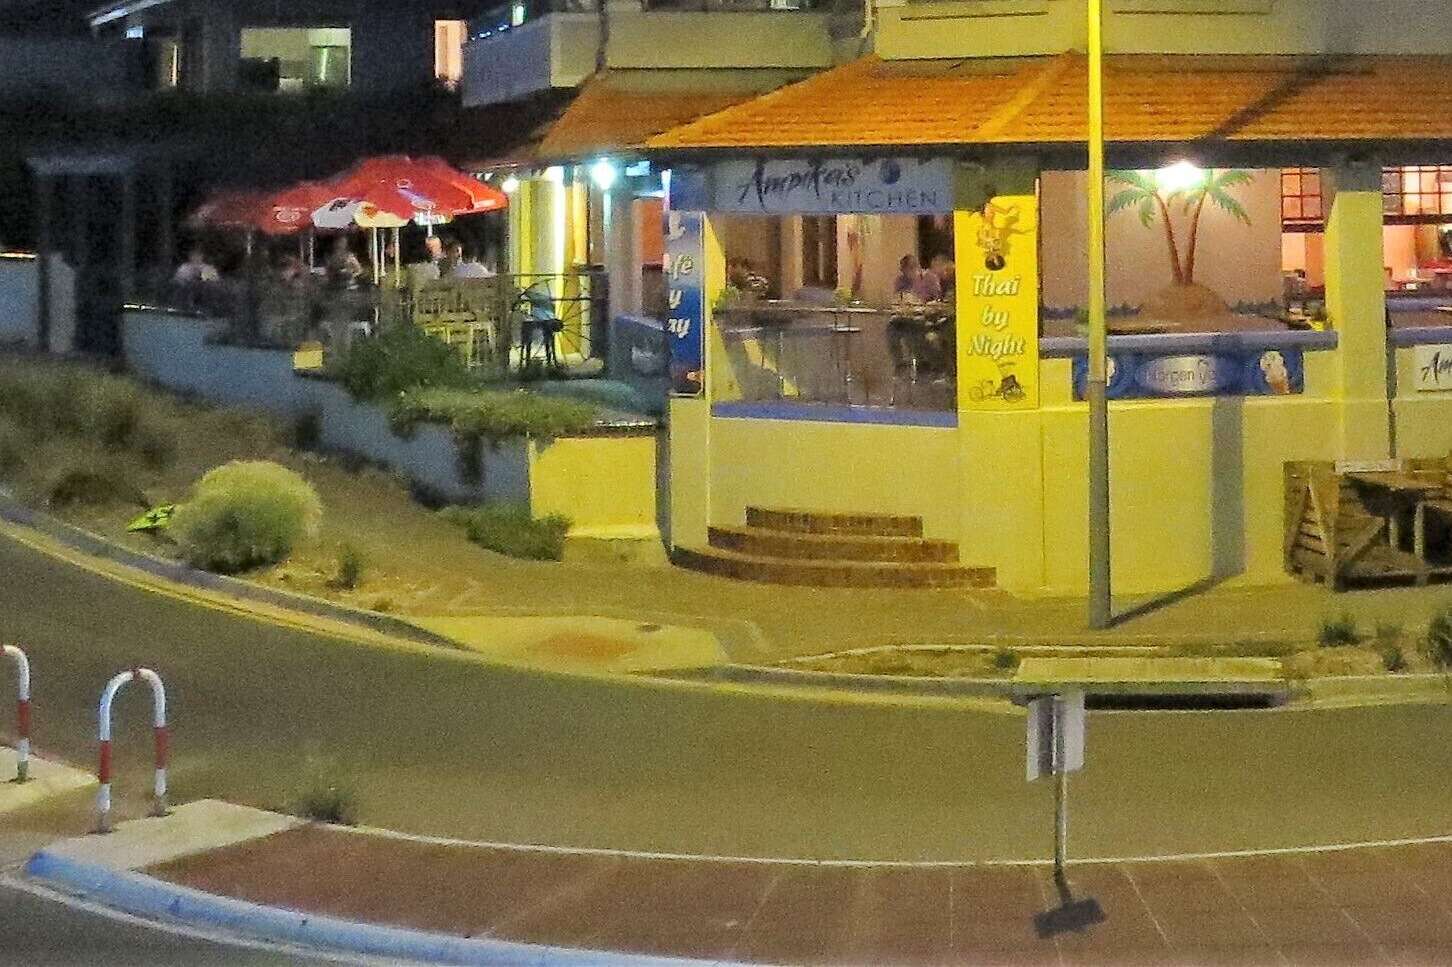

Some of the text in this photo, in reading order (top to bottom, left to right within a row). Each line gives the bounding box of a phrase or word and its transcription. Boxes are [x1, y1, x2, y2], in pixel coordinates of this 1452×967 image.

[830, 189, 938, 209] KITCHEN
[972, 274, 1021, 297] Thai
[980, 305, 1010, 331] by
[967, 334, 1027, 361] Night
